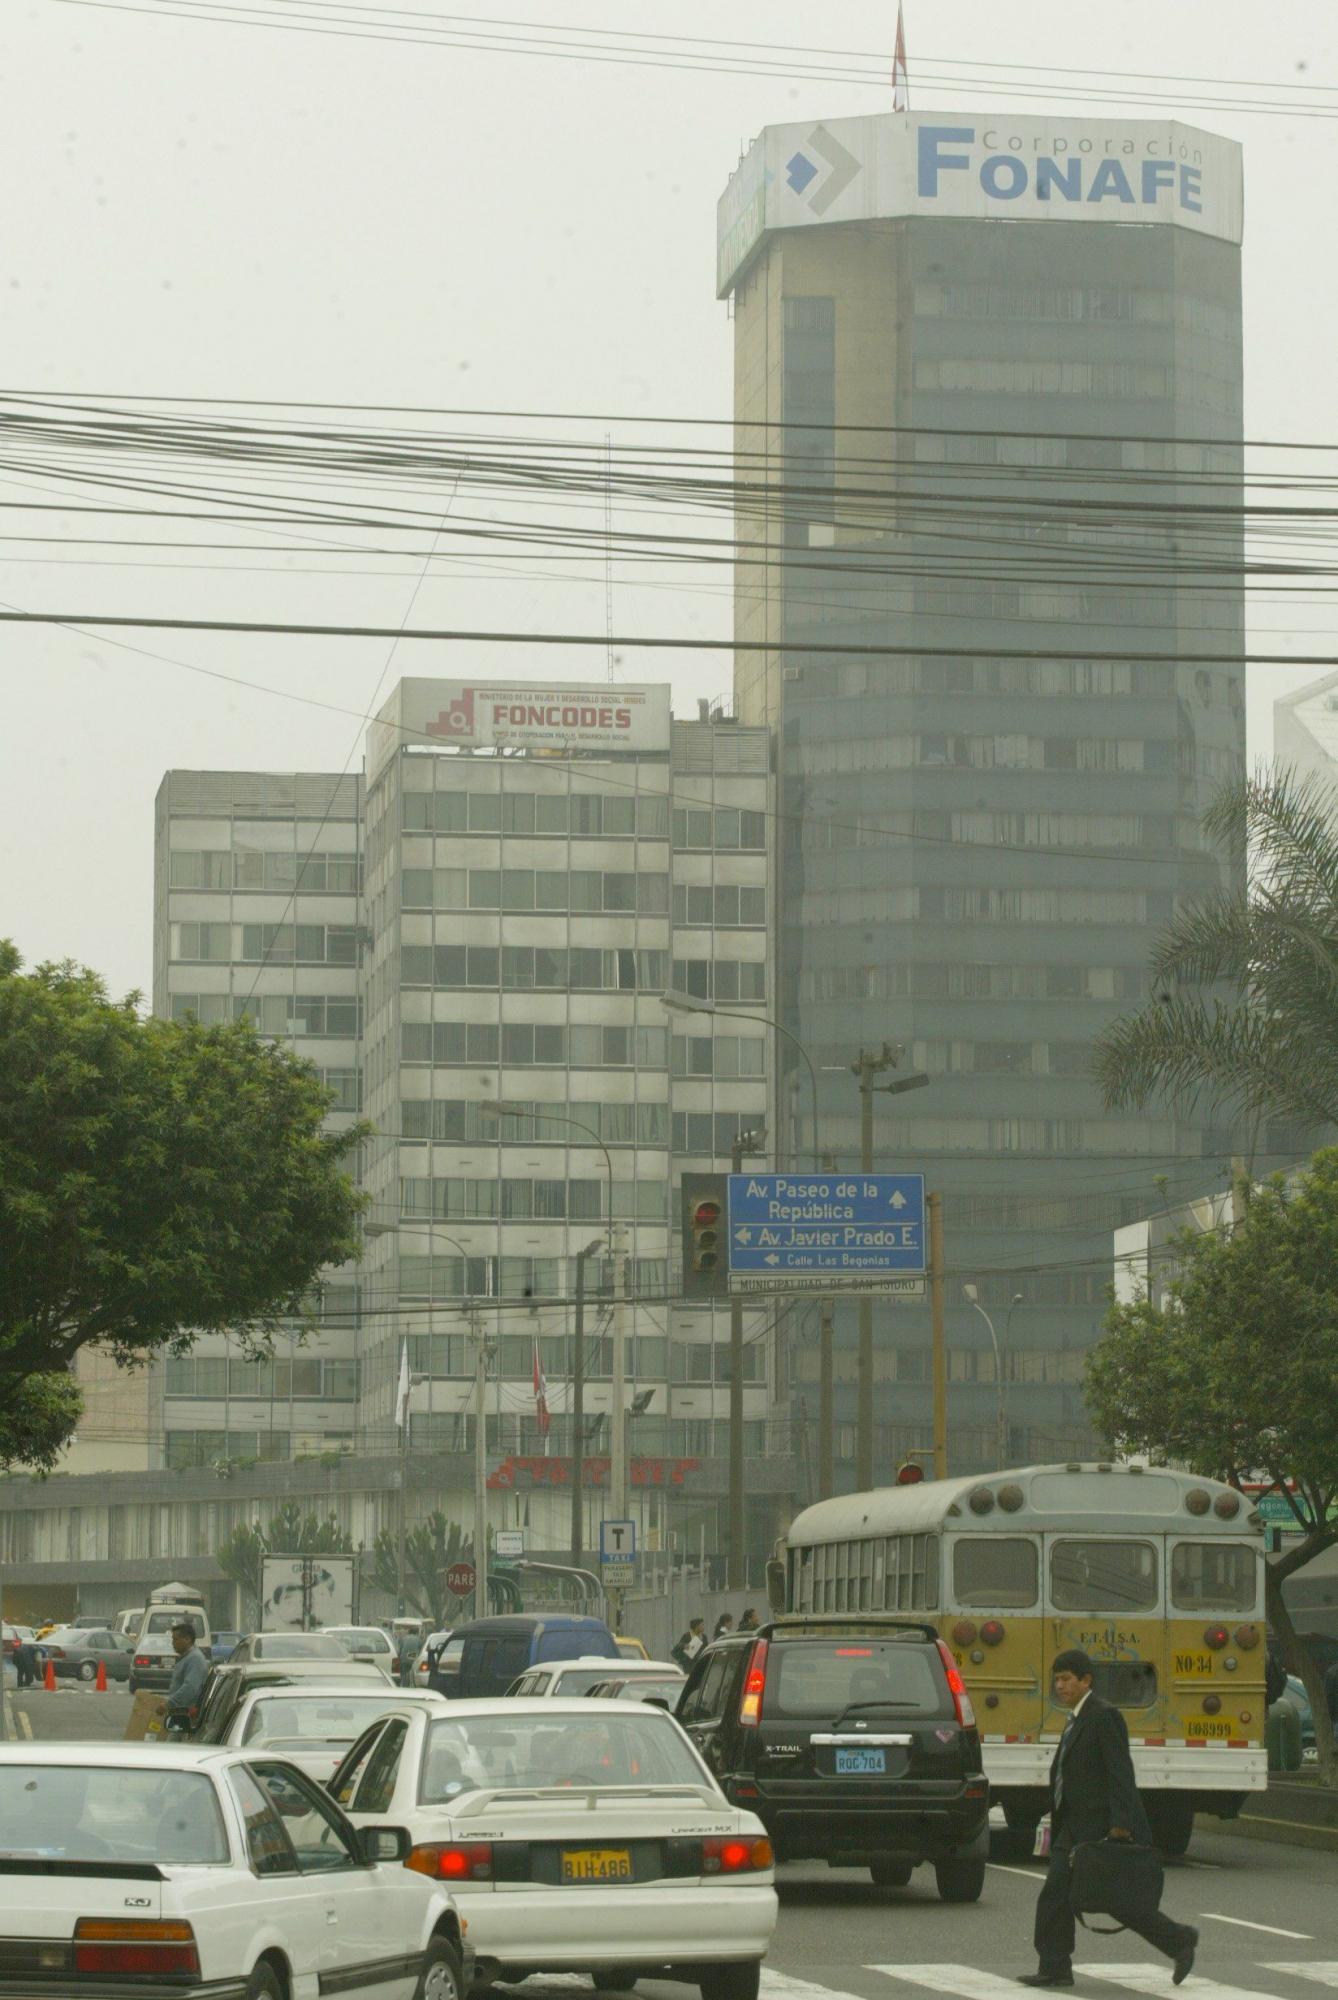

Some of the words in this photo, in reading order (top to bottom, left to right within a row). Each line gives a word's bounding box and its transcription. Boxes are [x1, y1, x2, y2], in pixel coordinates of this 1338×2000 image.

[981, 129, 1203, 163] Corporación
[917, 126, 1203, 213] FONAFE
[493, 704, 631, 729] FONCODES
[746, 1180, 769, 1198] Av.
[776, 1180, 830, 1199] Paseo
[835, 1180, 857, 1198] de
[863, 1182, 878, 1198] la
[769, 1200, 854, 1222] República
[758, 1227, 782, 1246] Av.
[784, 1227, 839, 1247] Javier
[844, 1226, 896, 1247] Prado
[902, 1226, 918, 1247] E.
[787, 1253, 813, 1267] Calle
[818, 1253, 837, 1267] Las
[842, 1253, 890, 1269] Begonias
[611, 1527, 625, 1550] T
[609, 1553, 630, 1563] TAXI
[448, 1573, 475, 1587] PARE
[765, 1744, 802, 1753] X-TRAIL
[564, 1857, 630, 1879] BIH-486
